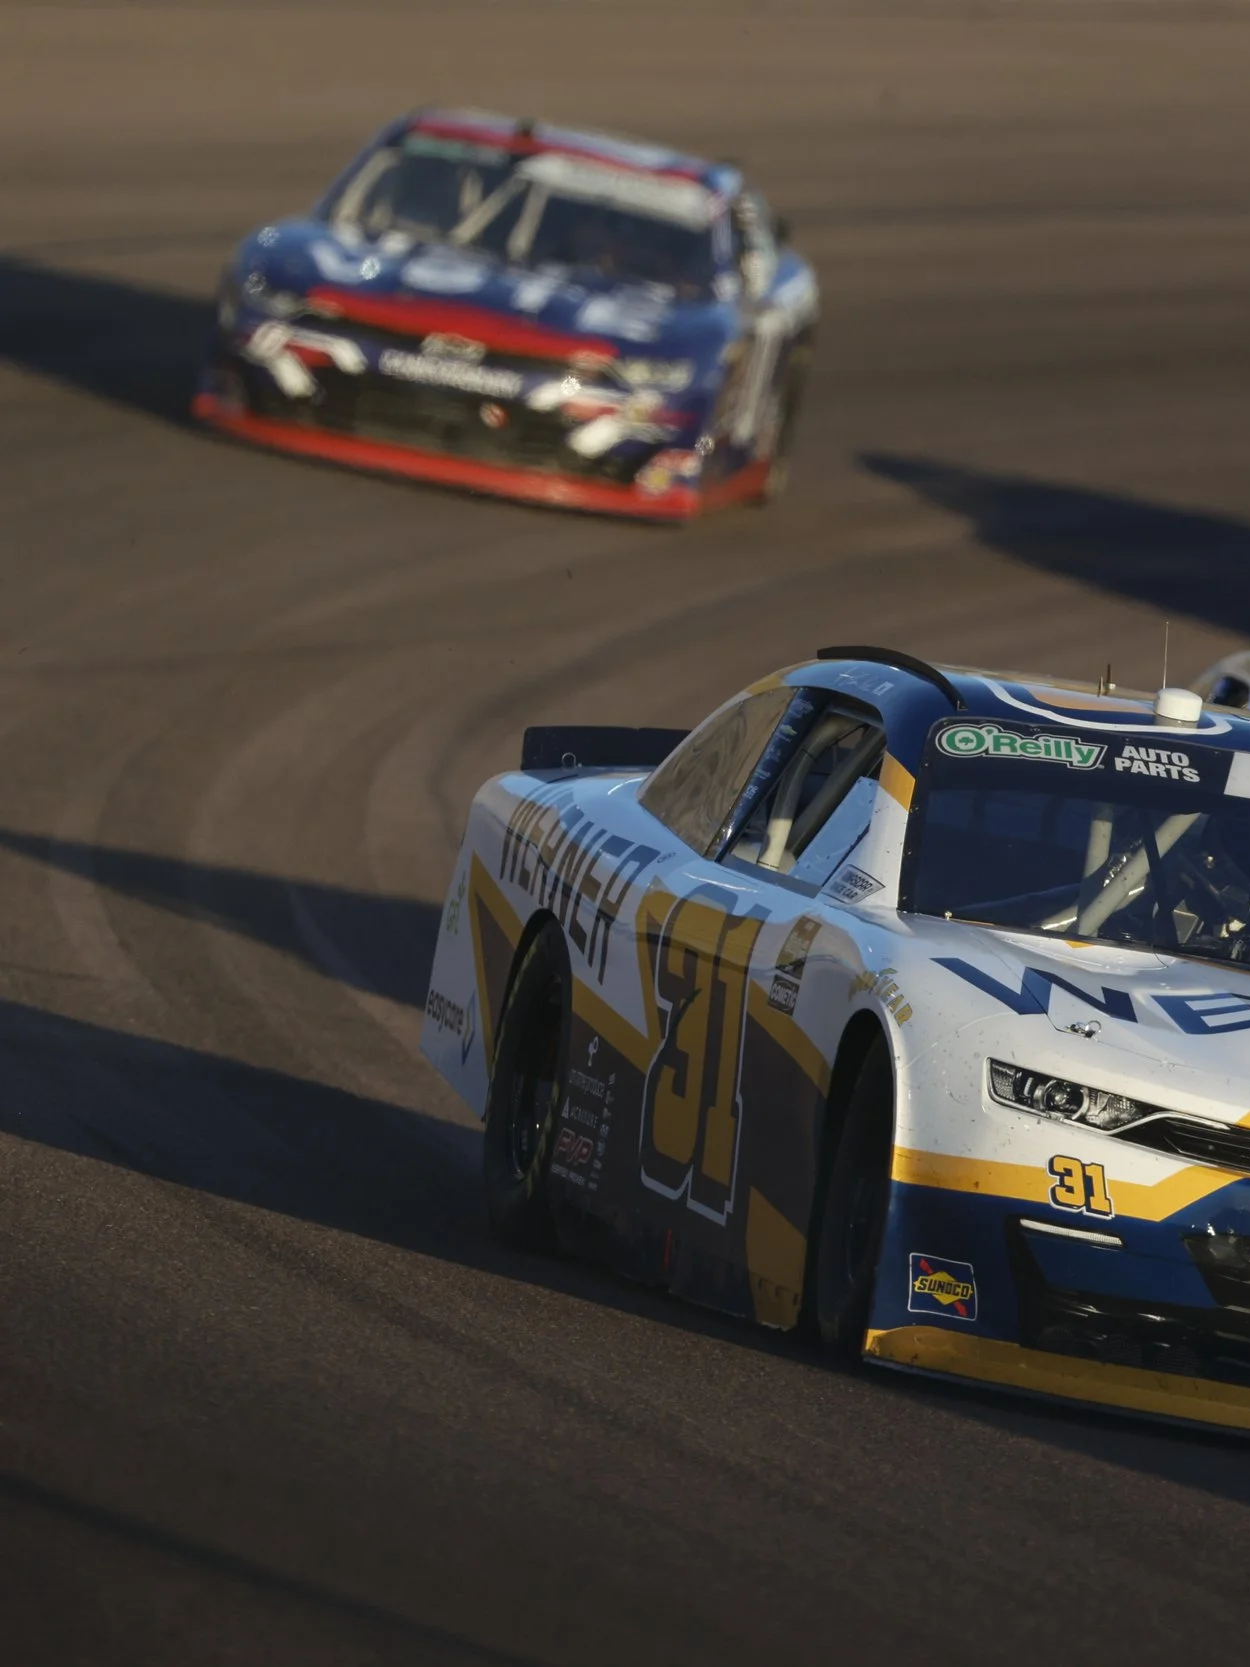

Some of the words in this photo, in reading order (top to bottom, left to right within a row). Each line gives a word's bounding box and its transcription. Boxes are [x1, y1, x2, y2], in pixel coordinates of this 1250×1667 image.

[943, 728, 1096, 766] O'Reilly
[1121, 744, 1190, 768] AUTO
[1113, 756, 1201, 784] PARTS
[499, 784, 661, 986] WERNER
[841, 869, 874, 892] SCAR
[425, 988, 464, 1037] easycare
[642, 881, 770, 1224] 31
[1048, 1155, 1116, 1220] 31
[917, 1277, 971, 1299] SUNOCO
